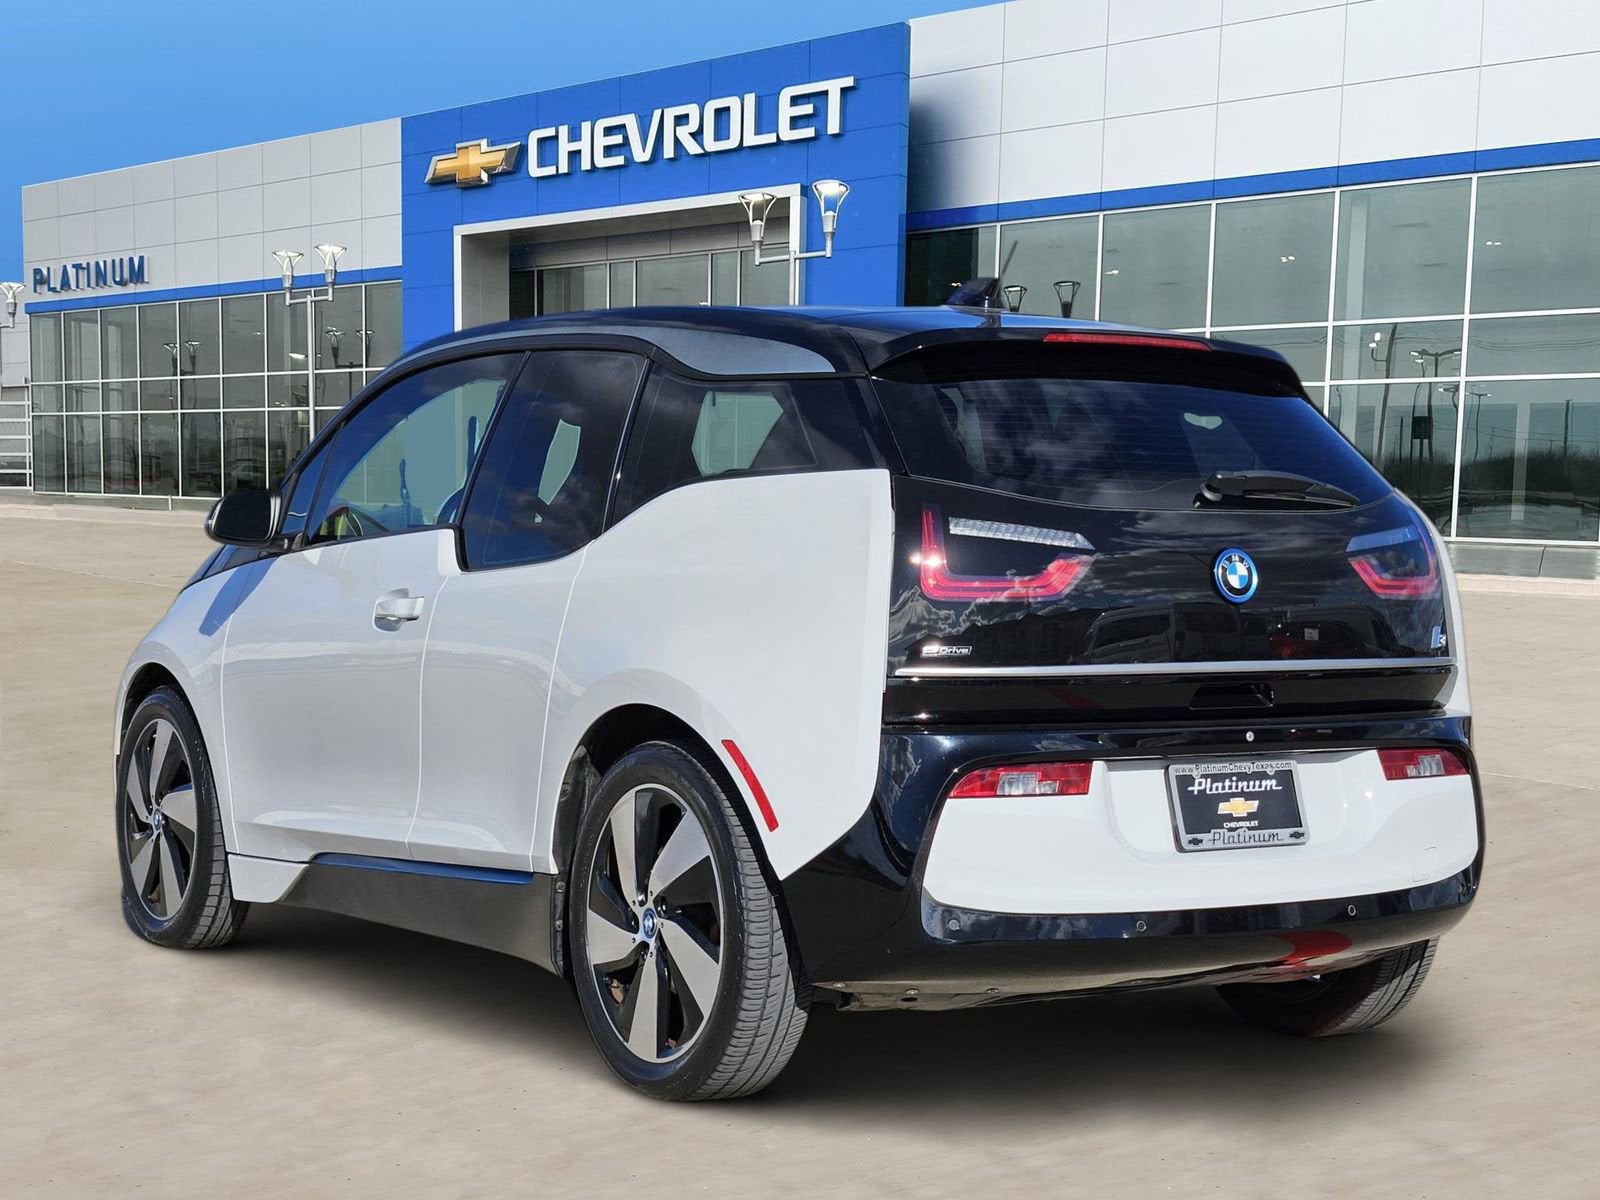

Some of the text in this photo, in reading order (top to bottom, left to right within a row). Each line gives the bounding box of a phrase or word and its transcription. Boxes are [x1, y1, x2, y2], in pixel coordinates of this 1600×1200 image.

[528, 76, 855, 178] CHEVROLET
[33, 255, 145, 294] PLATINUM
[1174, 761, 1292, 774] www.PlatinumChevyTexas.com
[1187, 776, 1283, 795] Platinum
[1223, 820, 1259, 829] CHEVROLET
[1207, 830, 1284, 846] Platinum
